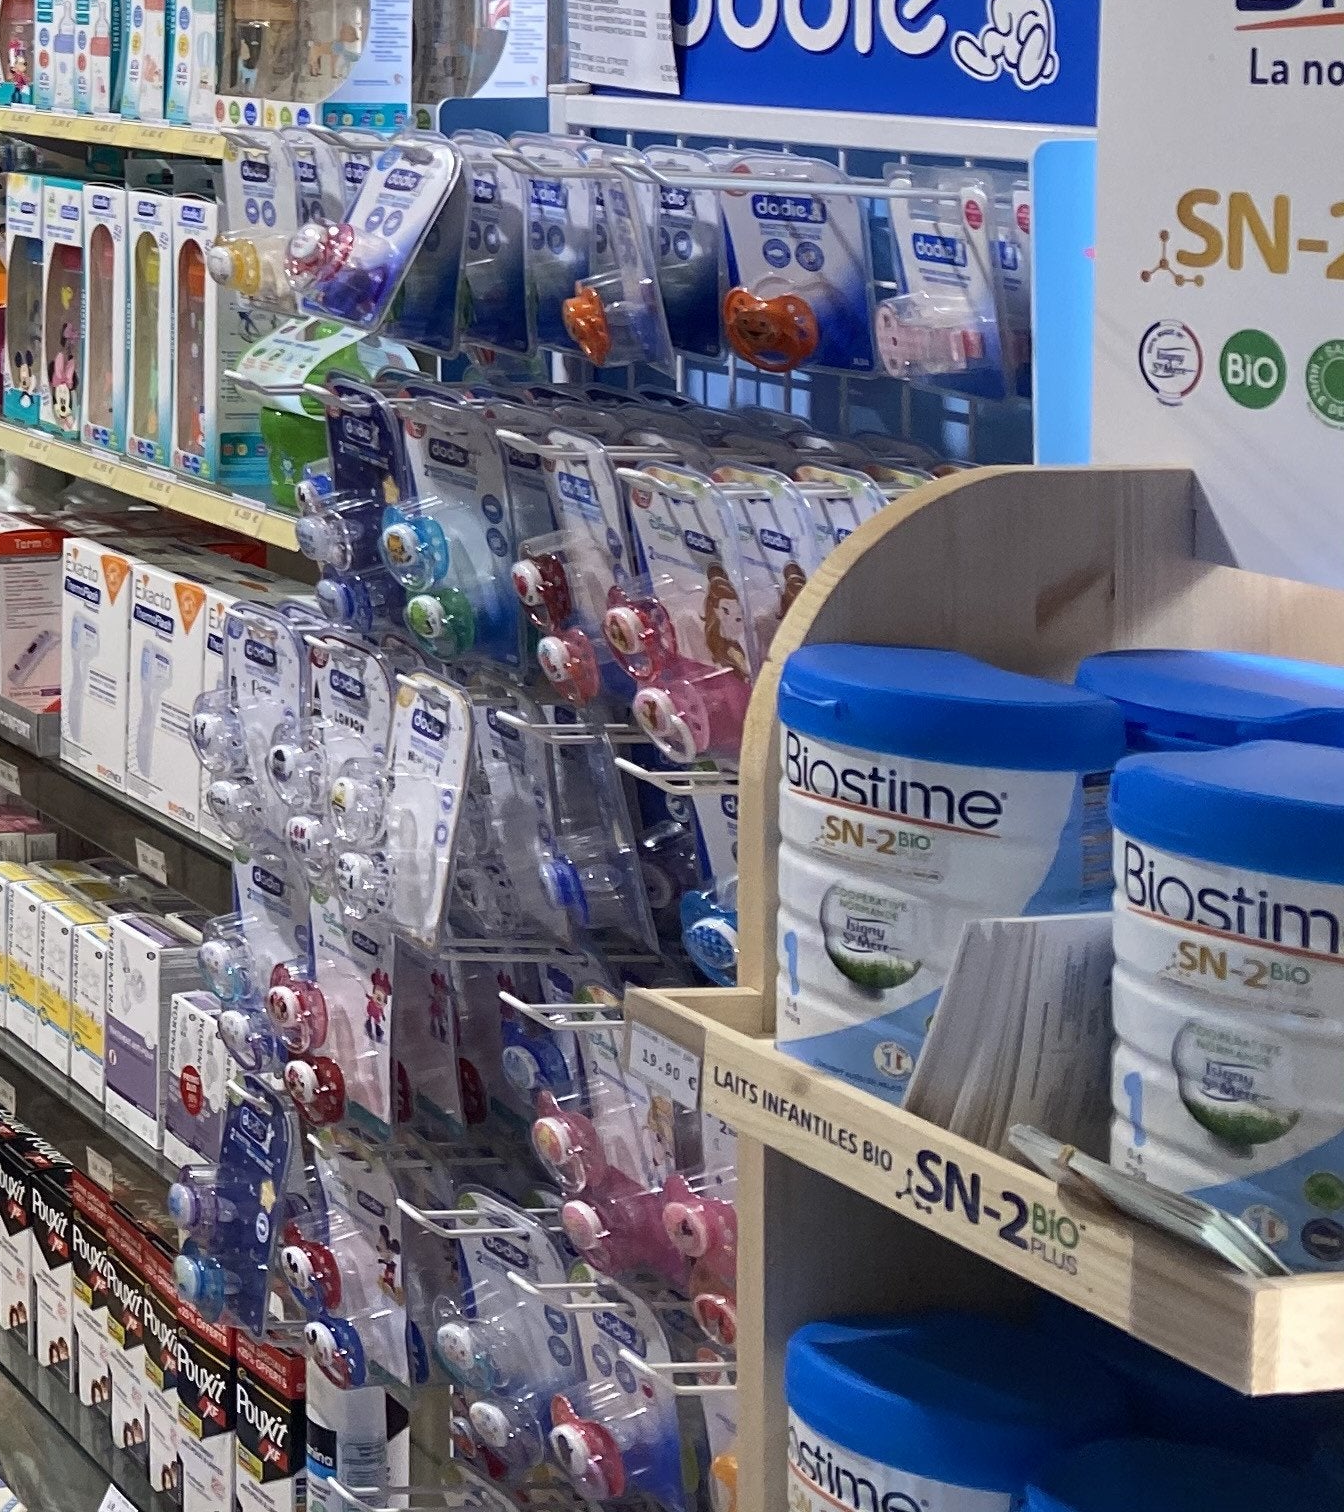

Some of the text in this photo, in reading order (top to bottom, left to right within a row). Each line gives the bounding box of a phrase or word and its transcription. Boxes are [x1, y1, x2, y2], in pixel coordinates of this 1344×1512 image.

[1251, 48, 1288, 86] La
[755, 196, 807, 218] dodie
[66, 552, 98, 583] Exacto
[135, 578, 172, 611] Exacto
[786, 730, 1003, 830] Biostime
[823, 814, 896, 855] SN-2
[1178, 939, 1269, 989] SN-2
[641, 1046, 698, 1091] 19.90 €
[713, 1065, 758, 1105] LAITS
[762, 1089, 858, 1157] INFANTILES
[862, 1141, 893, 1173] BIO
[914, 1149, 1028, 1251] SN-2
[32, 1187, 68, 1238] Pouxit
[1031, 1234, 1079, 1277] PLUS
[177, 1343, 226, 1404] Pouxit
[237, 1383, 288, 1447] Pouxit
